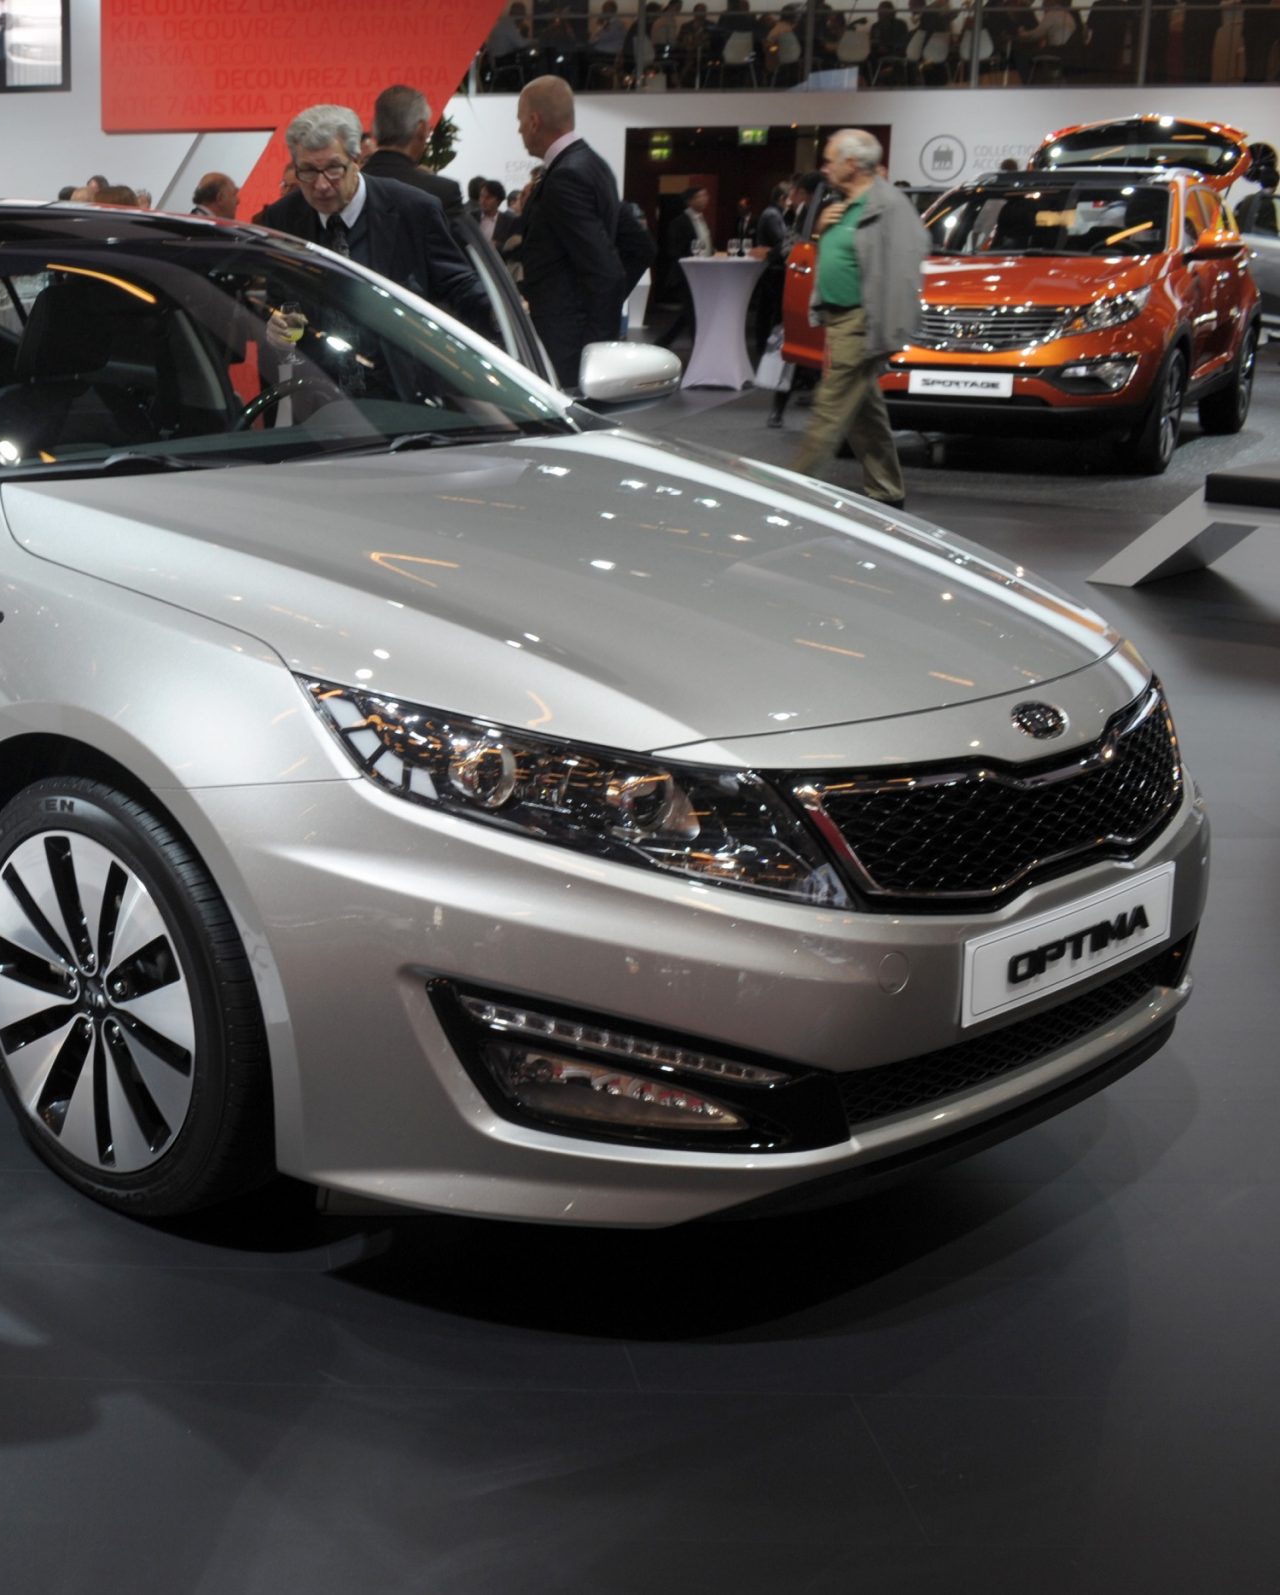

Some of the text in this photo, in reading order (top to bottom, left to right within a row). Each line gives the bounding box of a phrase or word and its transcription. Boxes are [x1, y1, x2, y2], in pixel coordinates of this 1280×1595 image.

[162, 17, 297, 41] DECOUVREZ
[214, 67, 348, 90] DECOUVREZ
[354, 67, 382, 88] LA
[921, 378, 1000, 389] SPORTAGE
[1007, 904, 1150, 984] OPTIMA
